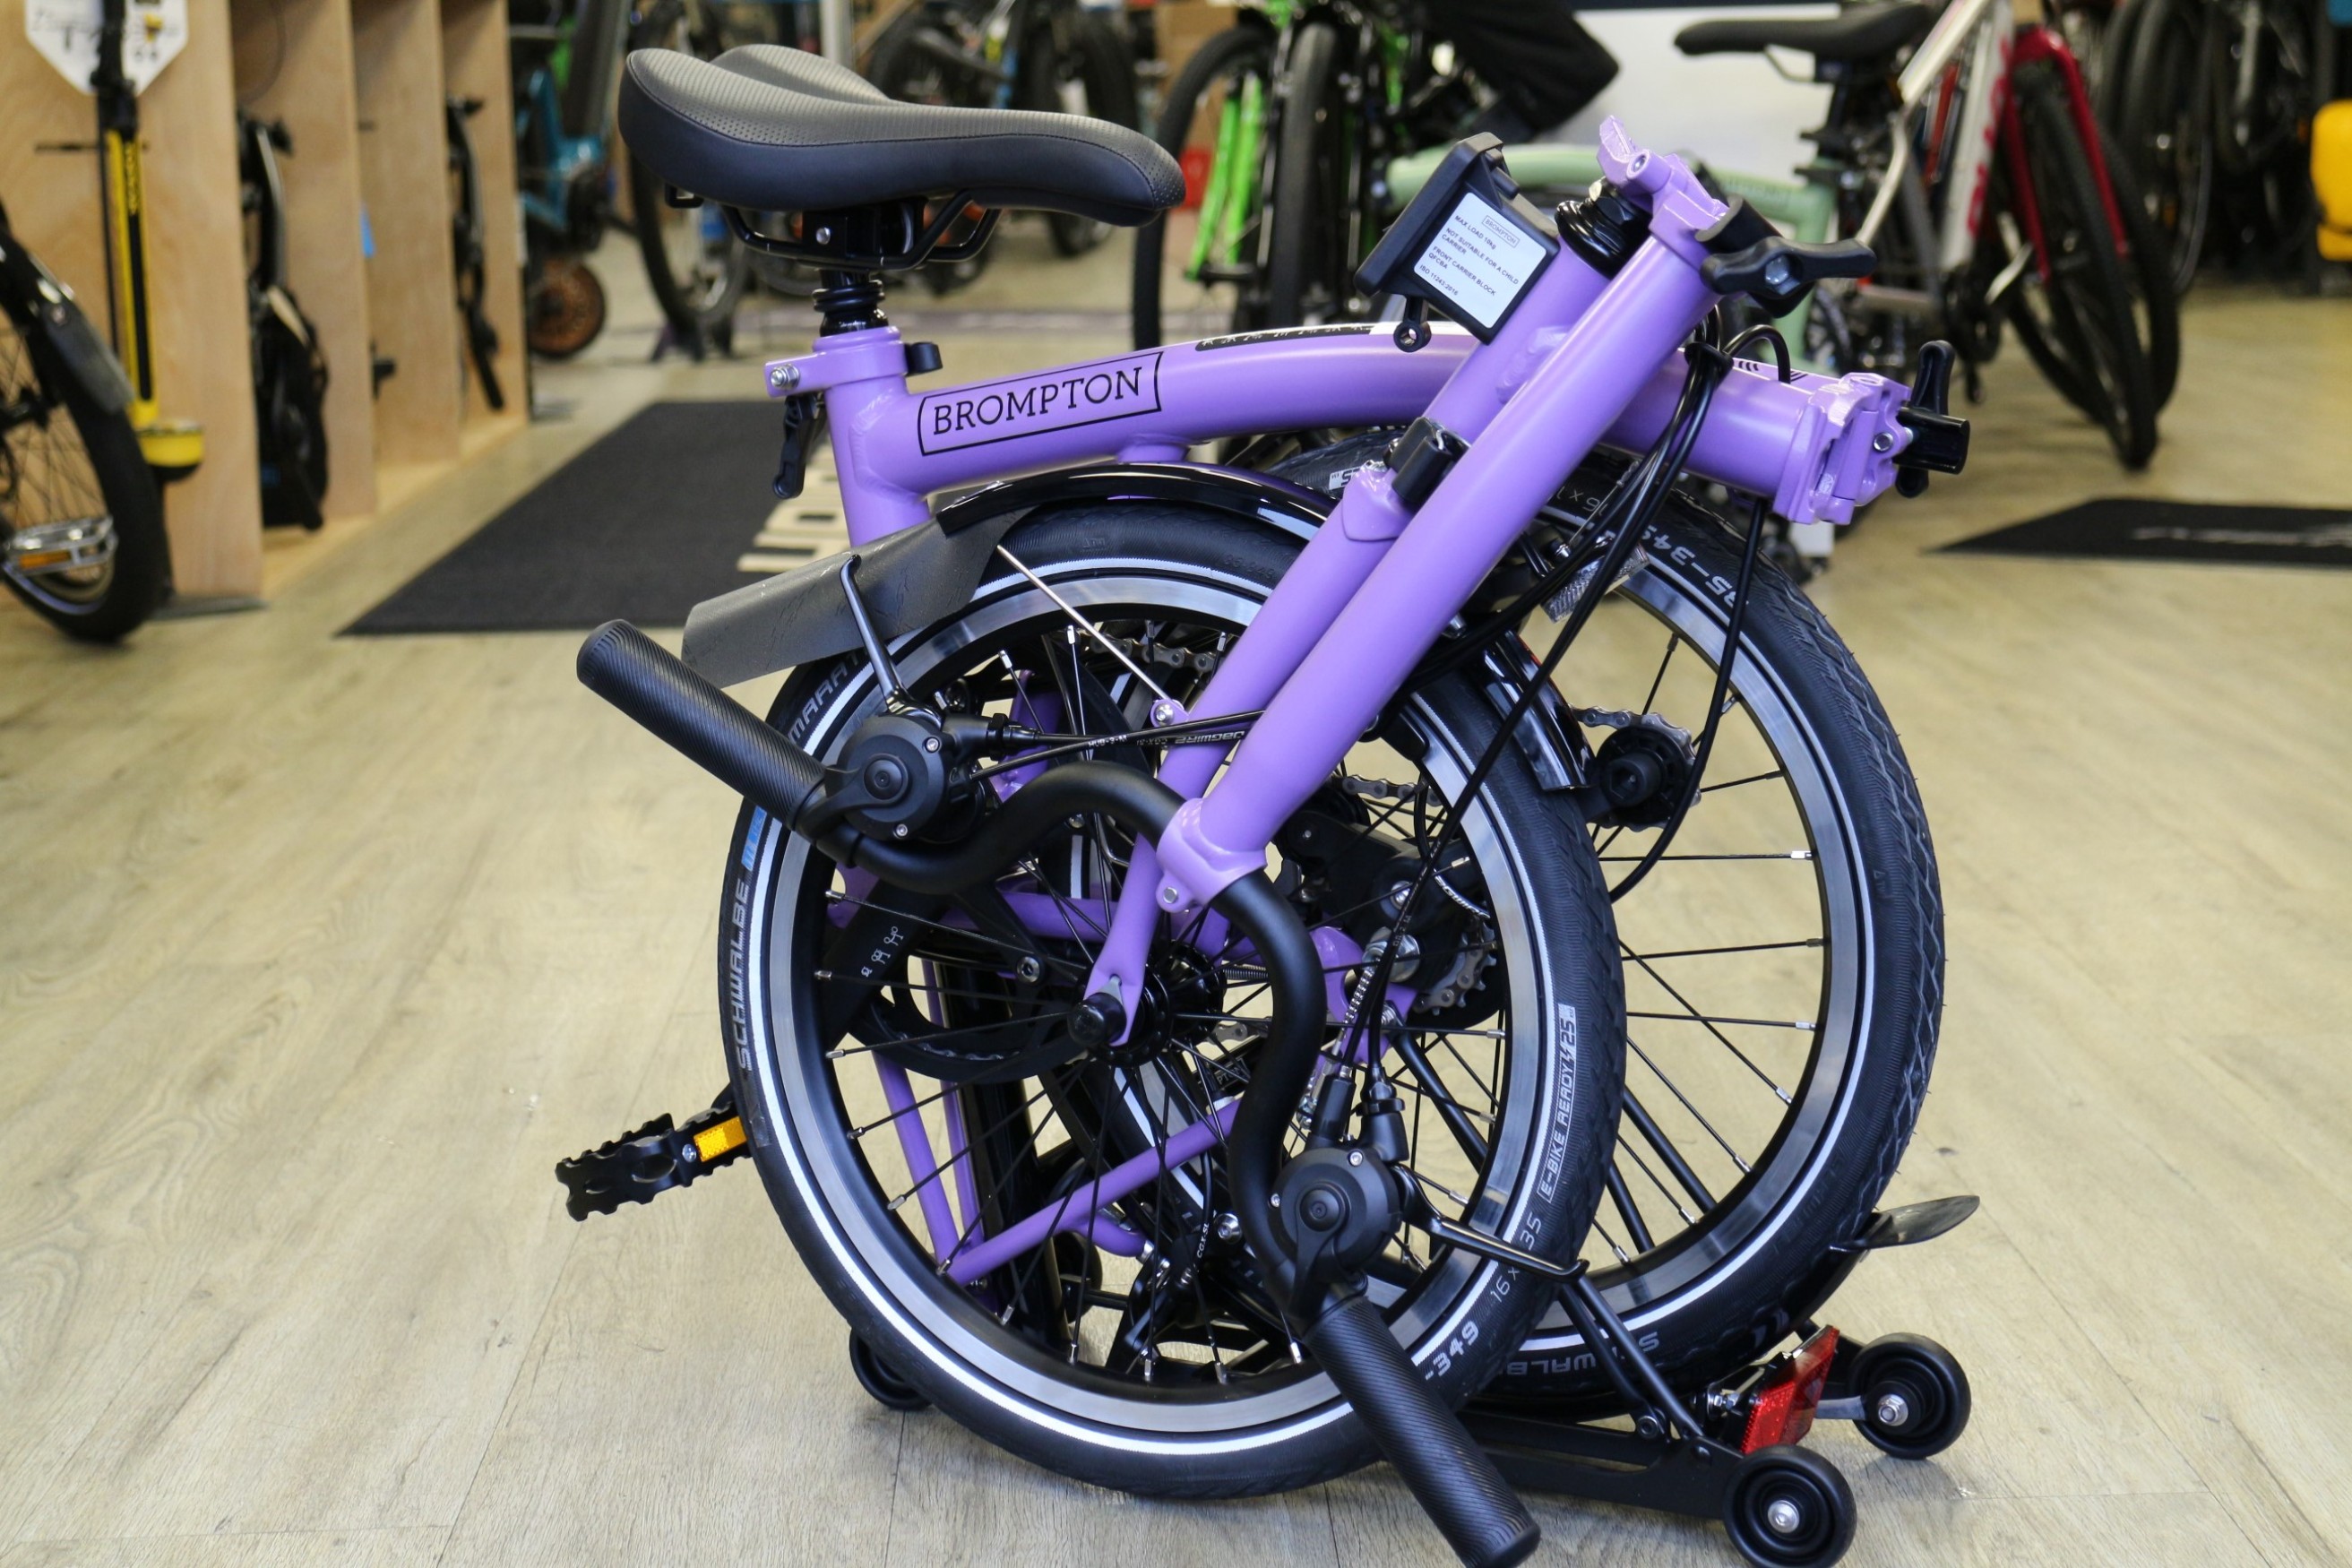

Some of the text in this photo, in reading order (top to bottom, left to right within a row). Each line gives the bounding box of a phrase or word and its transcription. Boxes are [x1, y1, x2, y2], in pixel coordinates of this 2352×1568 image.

[1441, 233, 1467, 255] CARRIER
[1454, 214, 1497, 251] MAX LOAD 10kg
[1484, 219, 1517, 246] BROMPTON
[1419, 263, 1431, 275] ISO
[1433, 246, 1496, 297] FRONT CARRIER BLOCK
[1445, 228, 1520, 286] NOT SUITABLE FOR A CHILD
[933, 366, 1142, 435] BROMPTON
[729, 878, 753, 1072] SCHWALBE
[1540, 1131, 1565, 1197] E-BIKE
[1560, 1017, 1575, 1047] 25
[1196, 1221, 1210, 1259] CGX-SL
[1490, 1278, 1511, 1302] 16
[1505, 1331, 1659, 1376] SWALB
